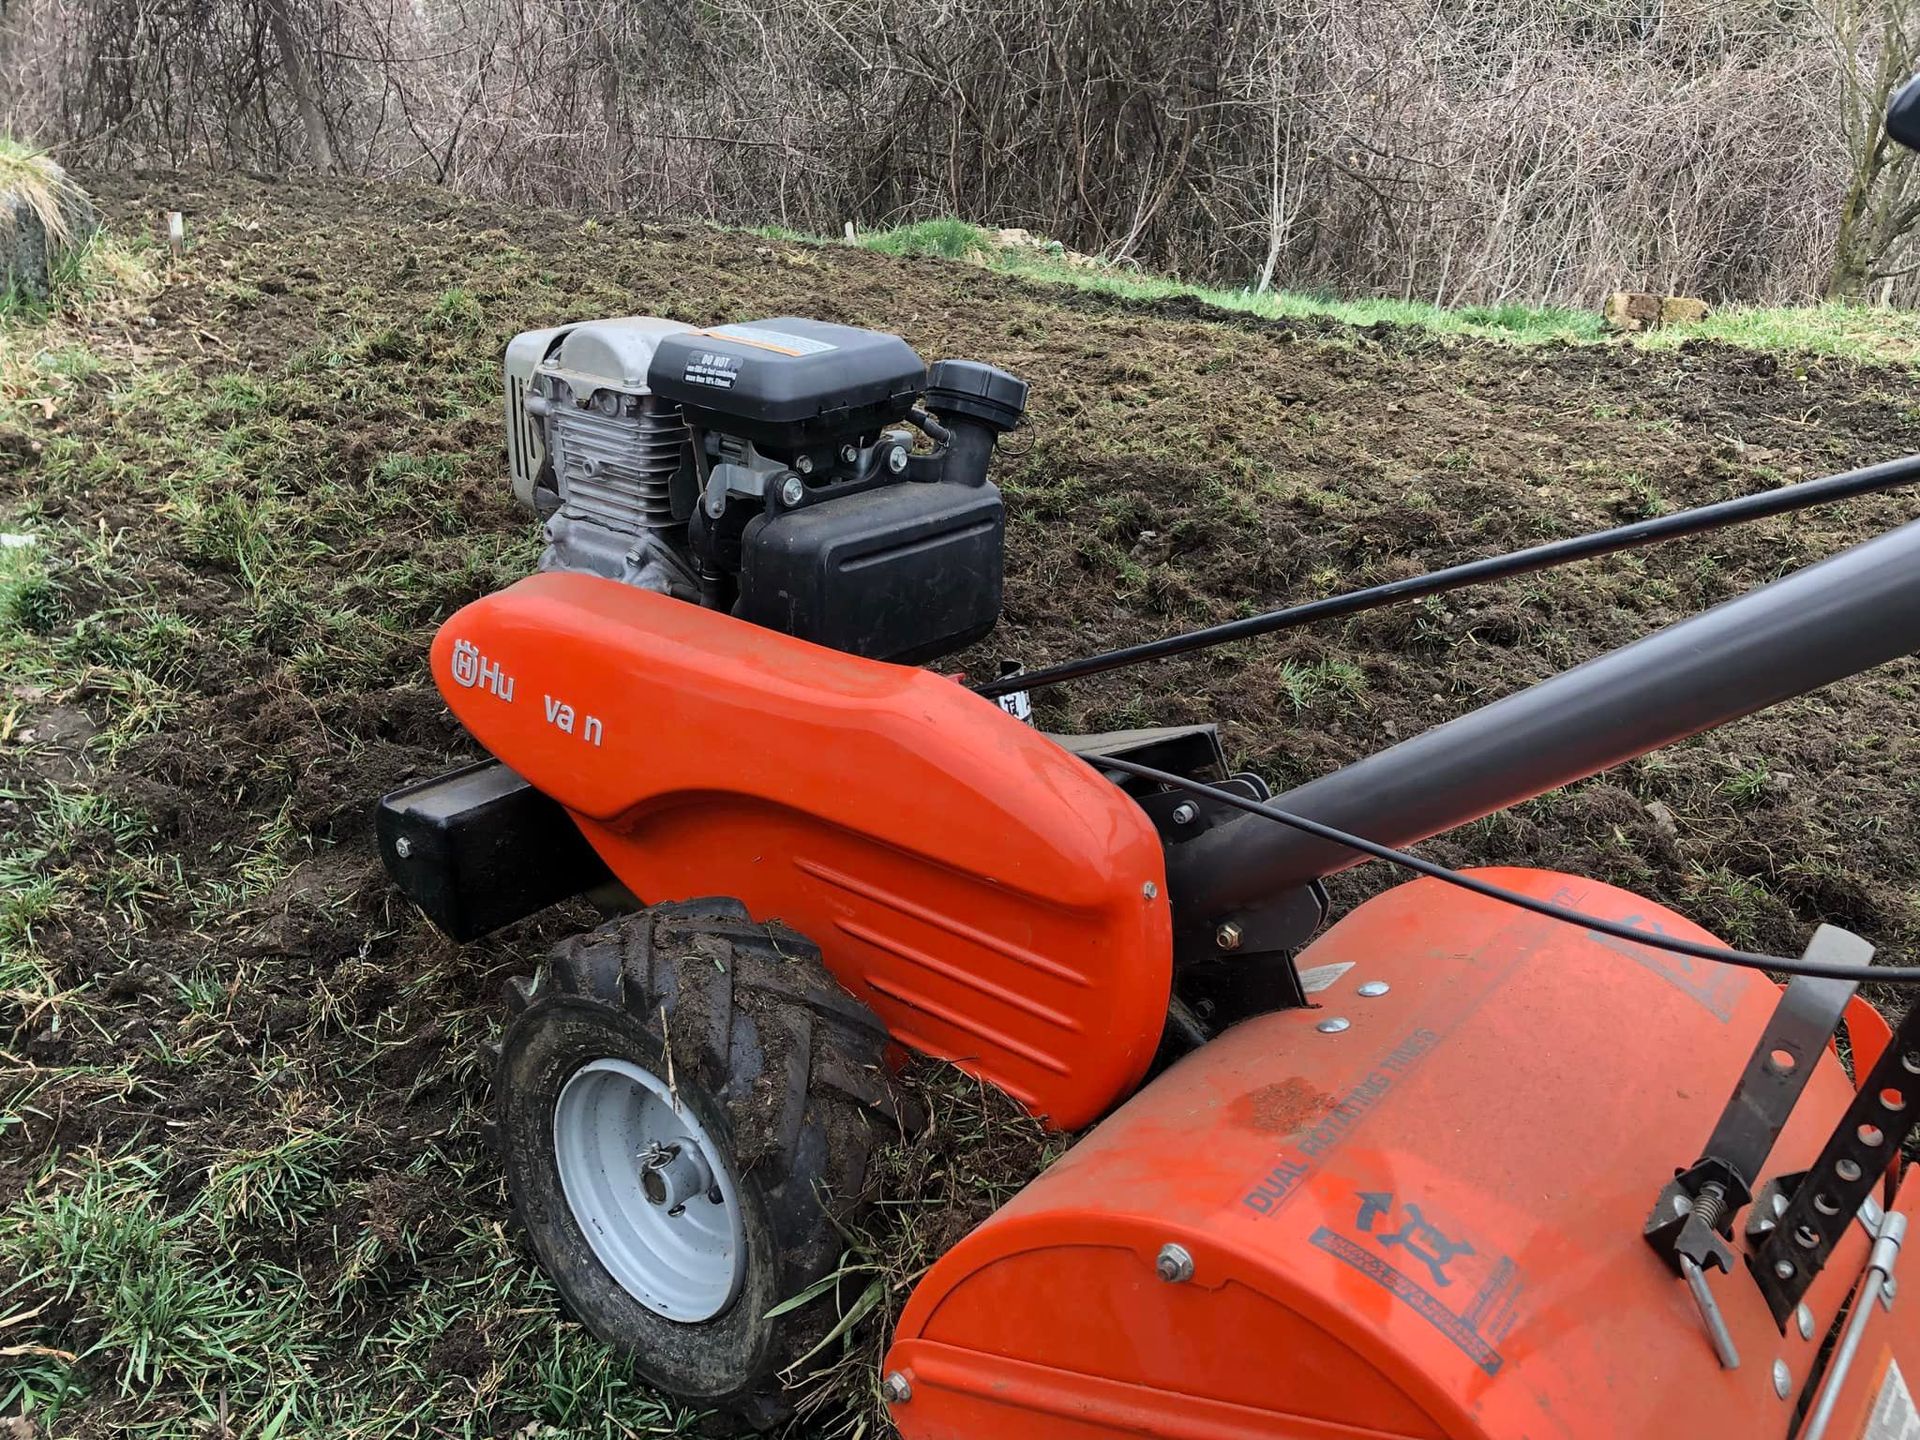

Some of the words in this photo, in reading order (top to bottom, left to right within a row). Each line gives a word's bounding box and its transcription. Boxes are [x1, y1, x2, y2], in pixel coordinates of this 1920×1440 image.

[701, 354, 714, 365] DO
[714, 356, 730, 368] NOT
[1243, 1160, 1310, 1216] DUAL
[1296, 1070, 1392, 1157] ROTATING
[1379, 1026, 1442, 1078] TINES
